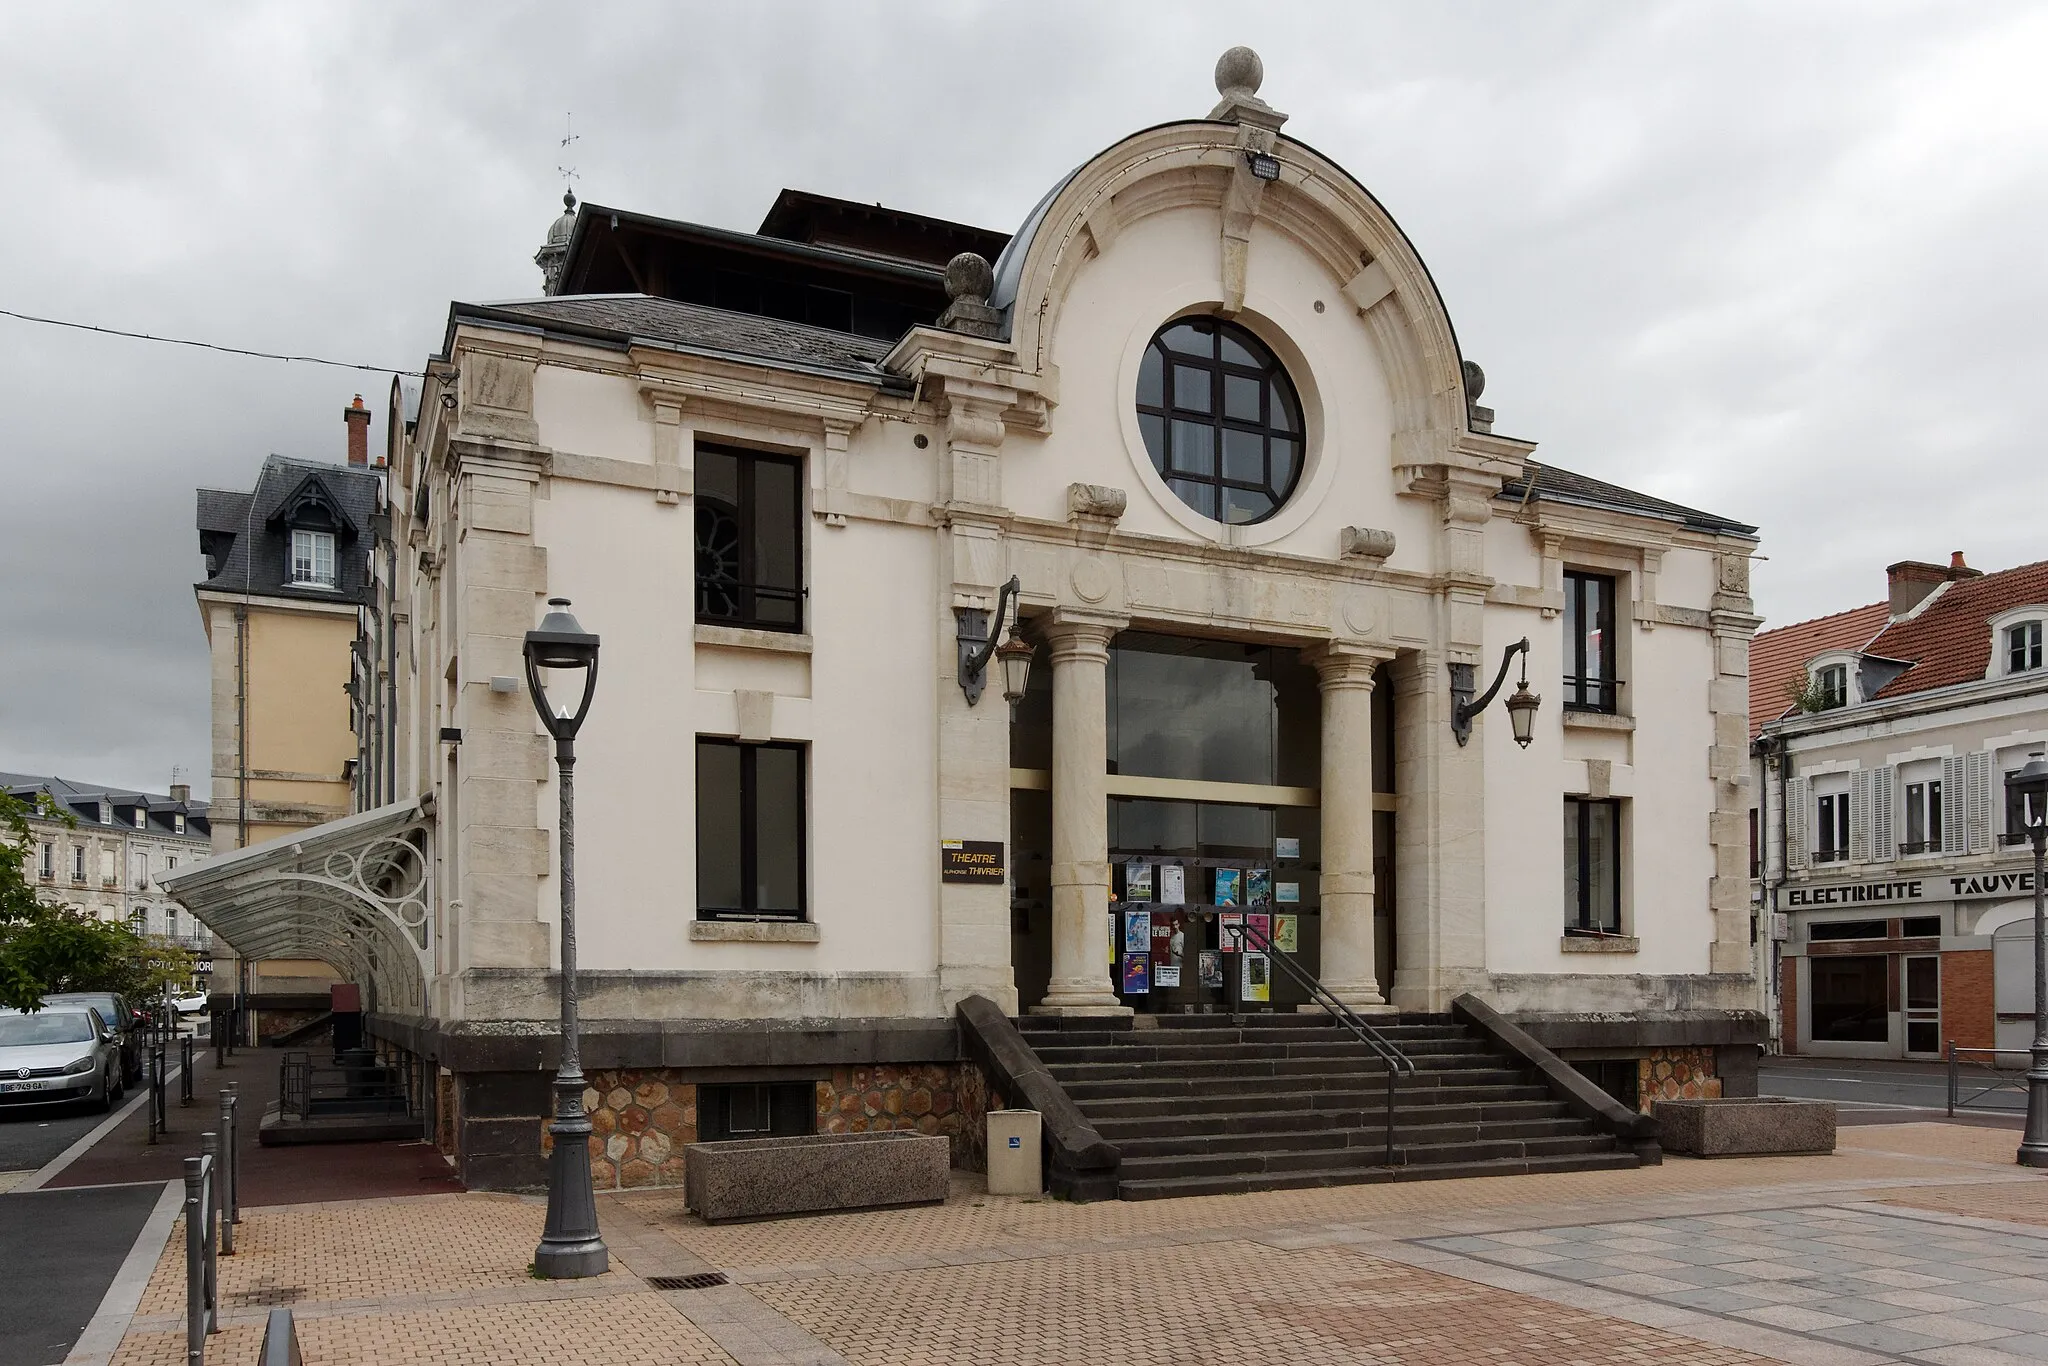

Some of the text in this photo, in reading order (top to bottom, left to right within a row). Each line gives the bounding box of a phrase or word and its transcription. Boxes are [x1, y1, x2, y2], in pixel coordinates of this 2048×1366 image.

[952, 853, 996, 863] THEATRE
[969, 867, 1004, 876] THIVRIER
[1789, 873, 2048, 906] ELECTRICITE TAUVE
[147, 960, 188, 971] OPTIQE
